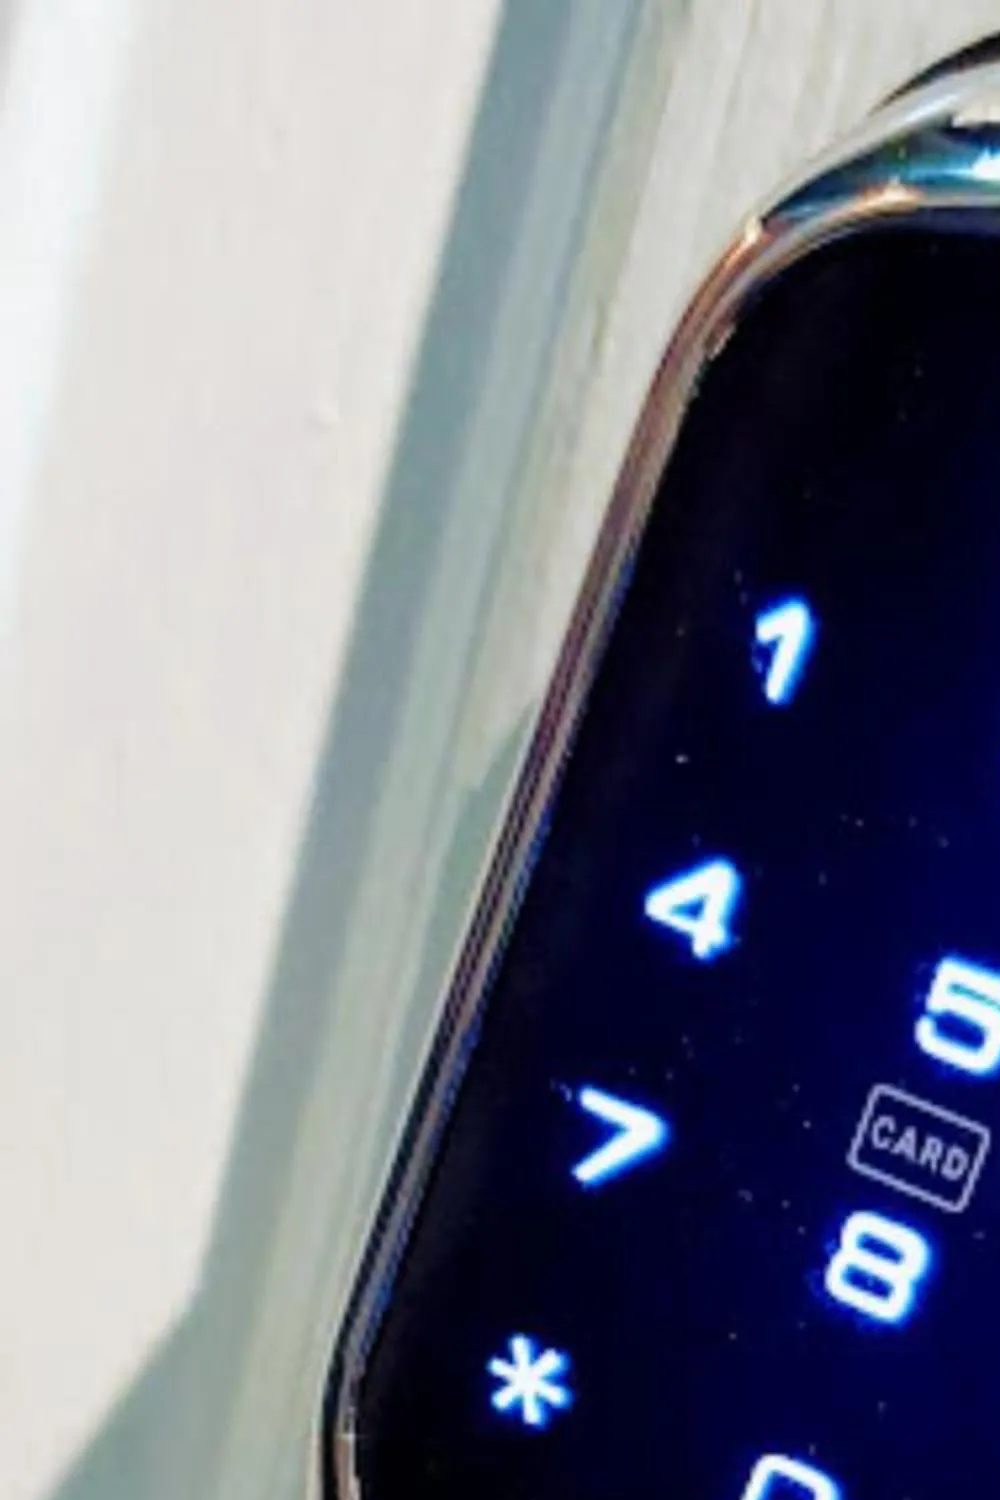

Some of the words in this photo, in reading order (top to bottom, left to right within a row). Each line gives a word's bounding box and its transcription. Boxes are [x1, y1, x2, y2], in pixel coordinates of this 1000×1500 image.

[752, 598, 814, 705] 1
[642, 858, 740, 960] 4
[570, 1086, 666, 1185] 7
[871, 1115, 969, 1181] CARD
[823, 1209, 932, 1325] 8
